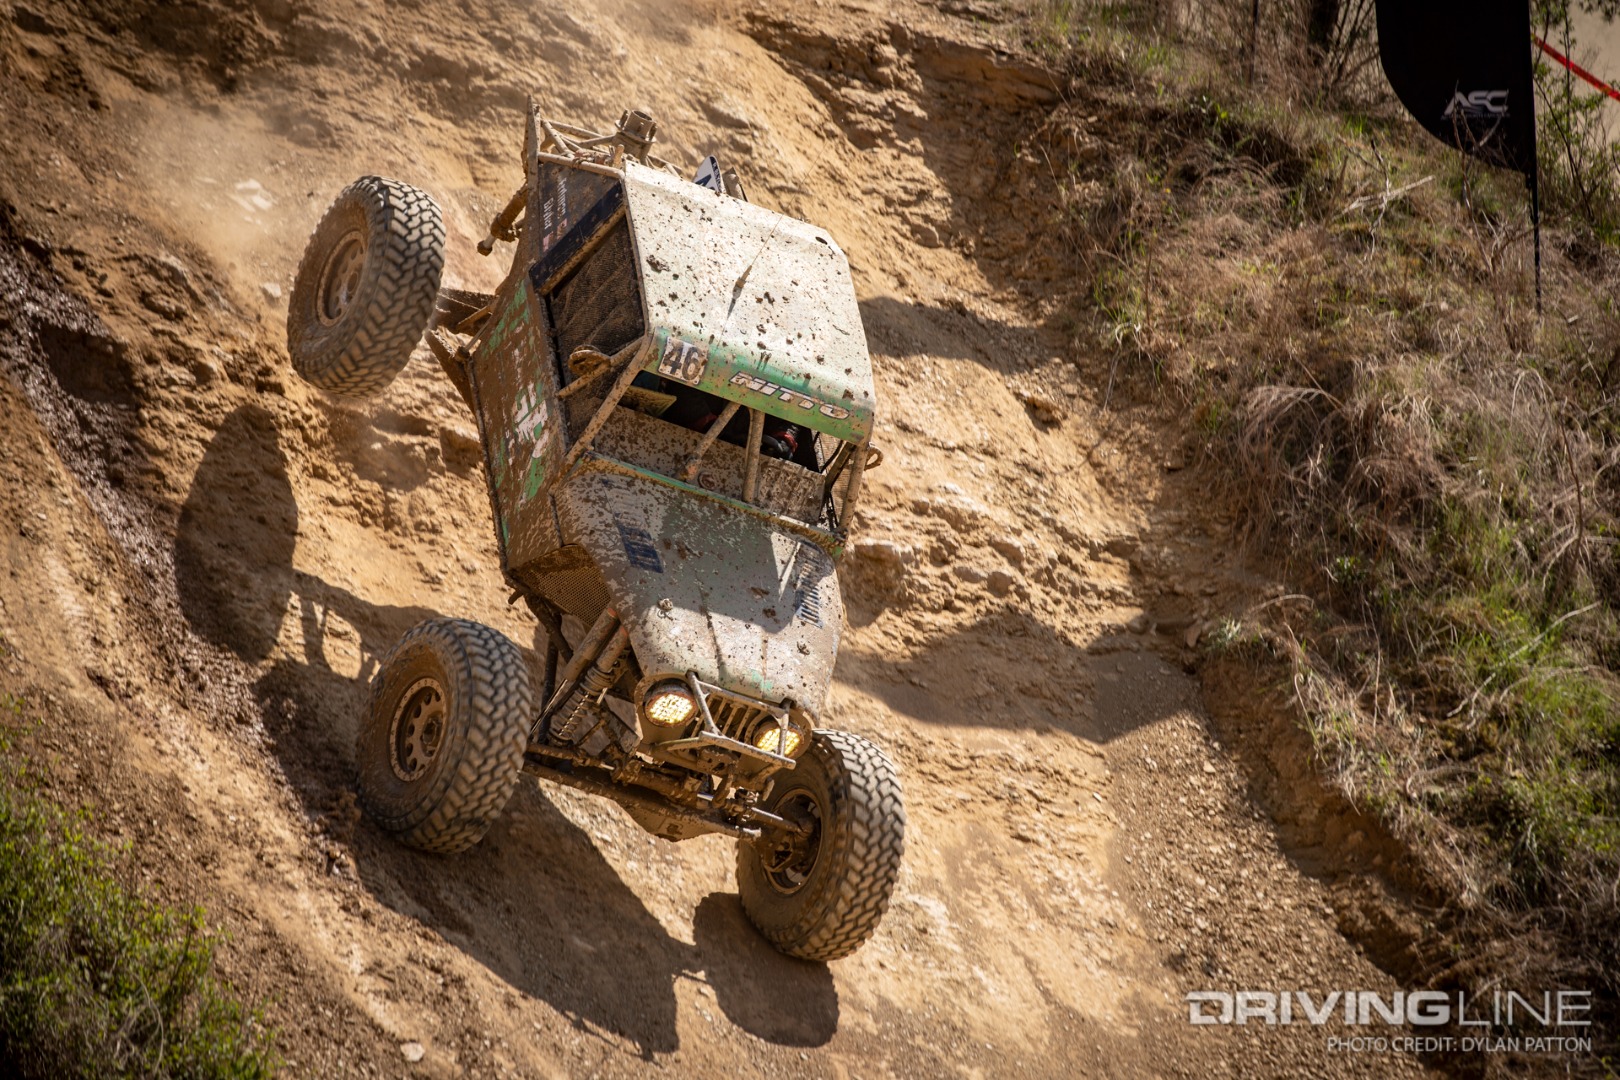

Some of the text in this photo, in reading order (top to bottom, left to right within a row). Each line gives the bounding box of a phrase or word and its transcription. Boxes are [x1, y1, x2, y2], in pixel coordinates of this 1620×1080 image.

[1444, 90, 1509, 115] ASC
[663, 342, 702, 382] 46
[729, 371, 850, 420] NITTO
